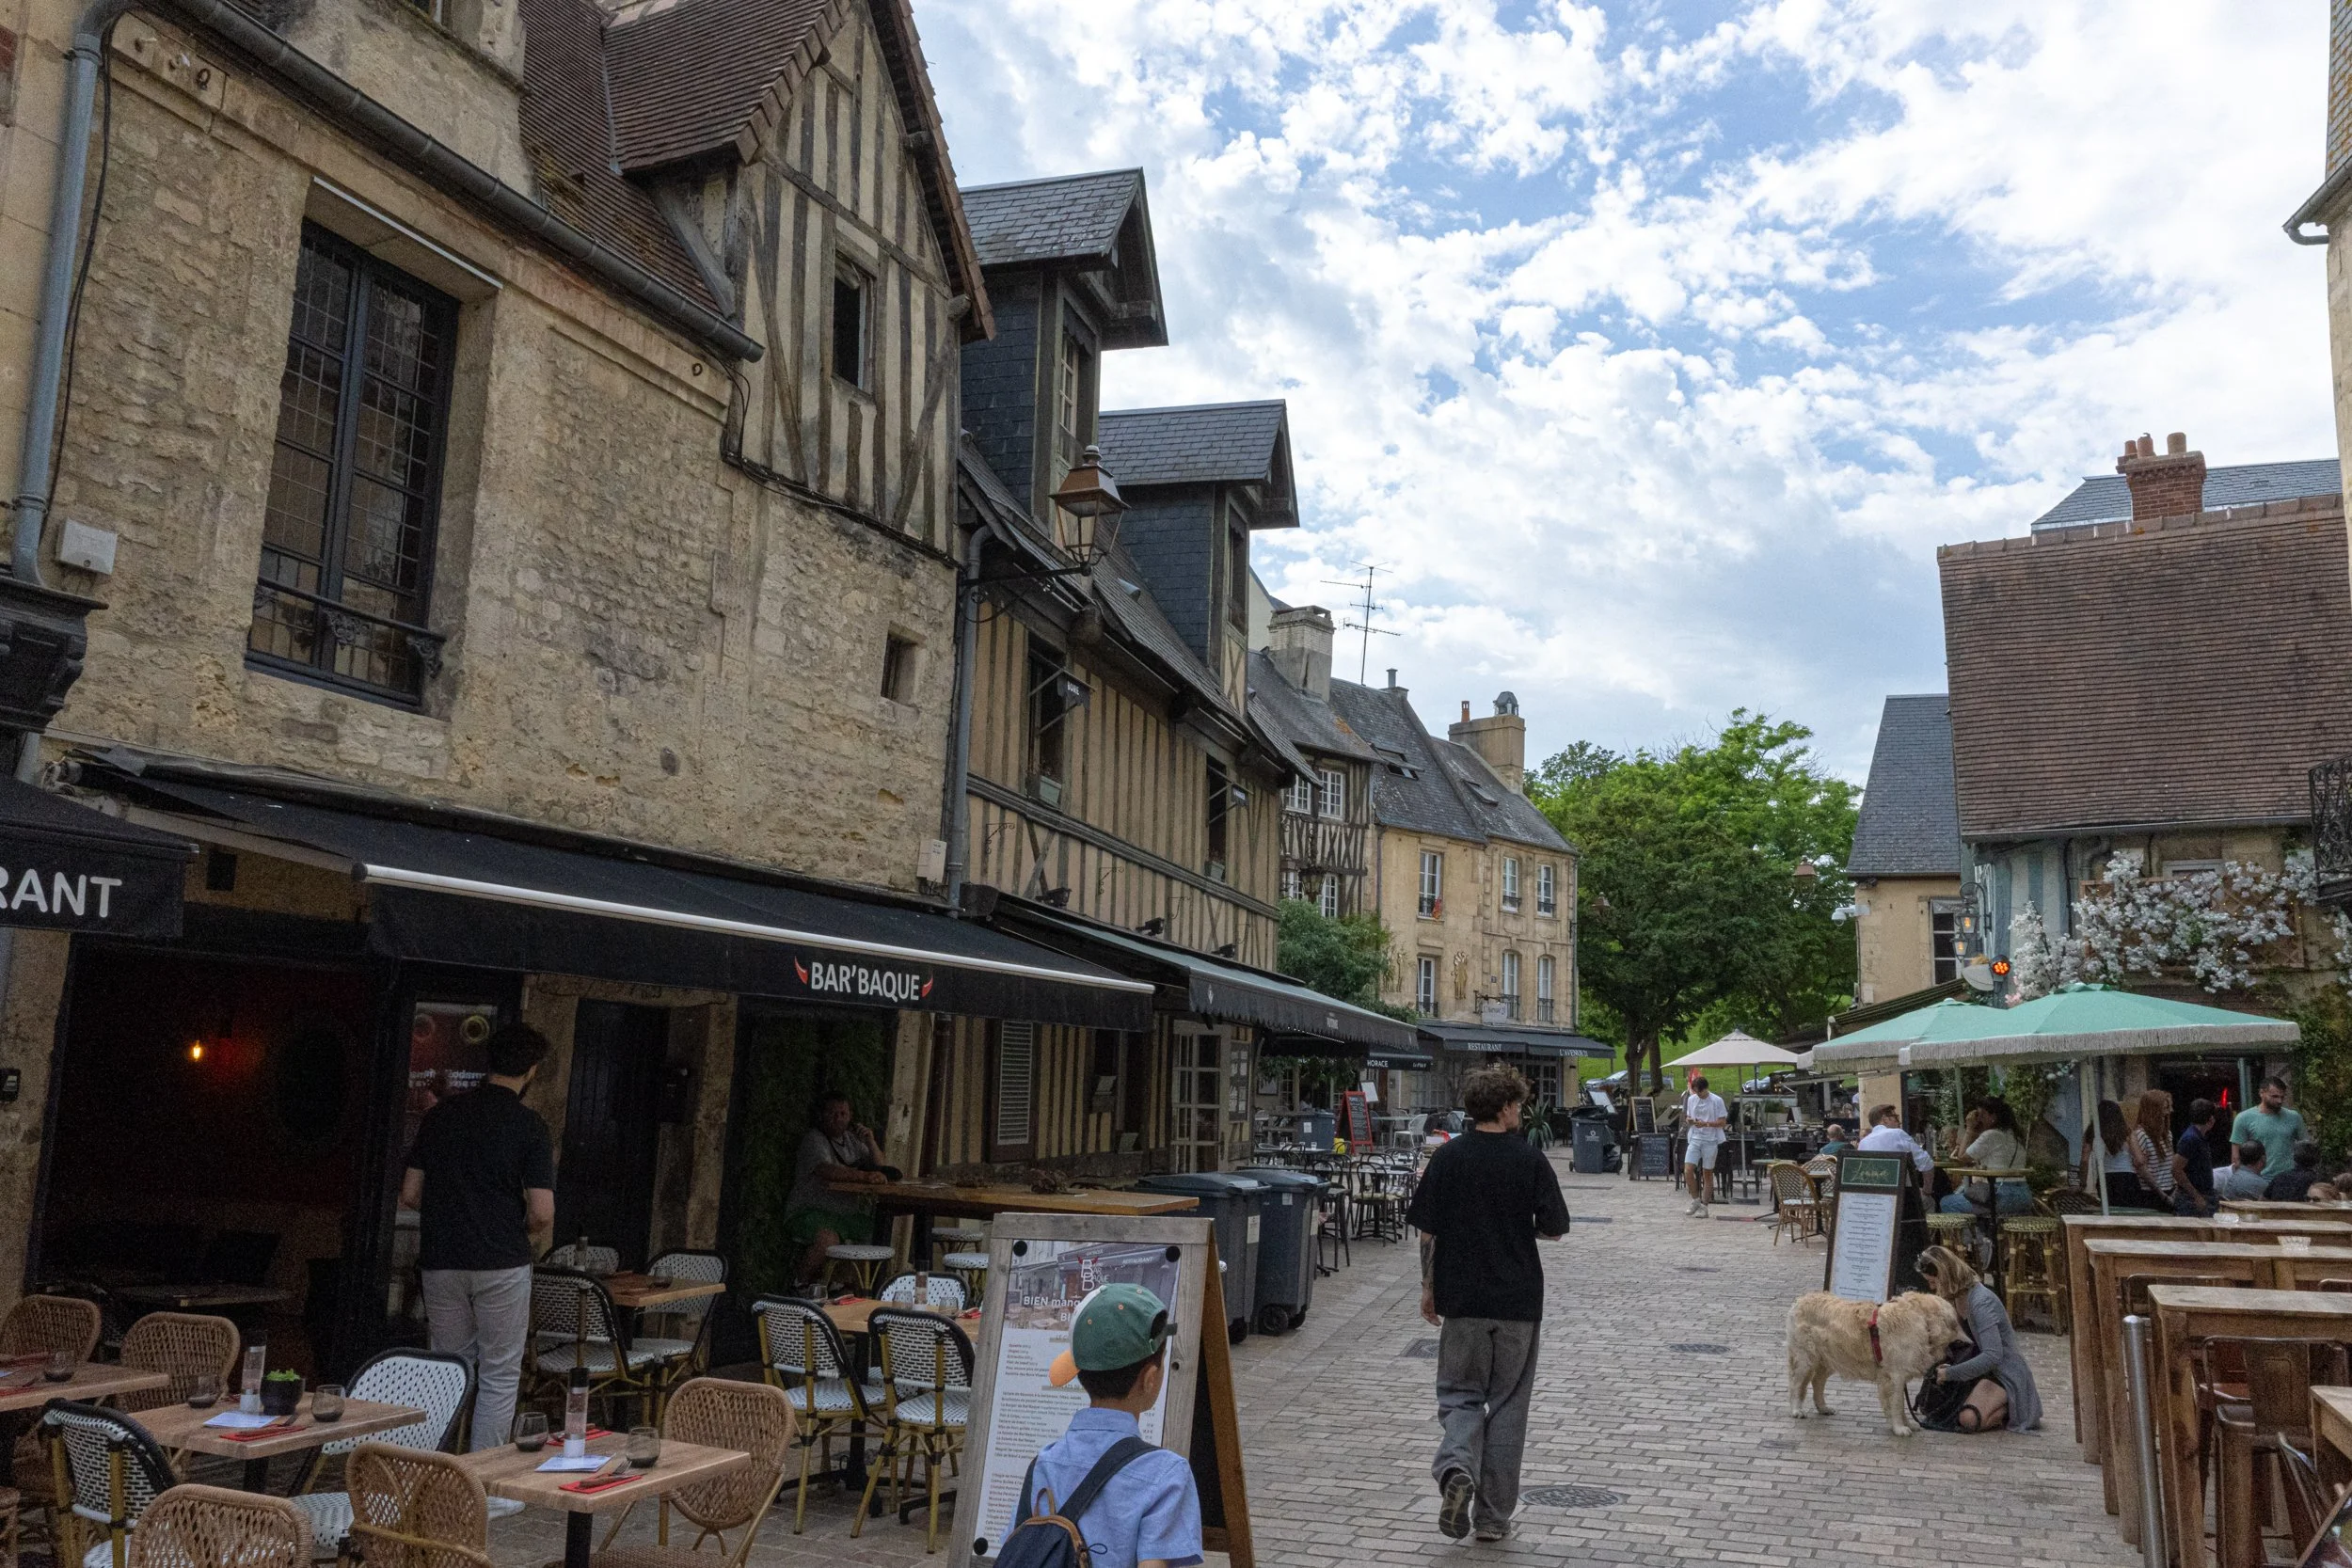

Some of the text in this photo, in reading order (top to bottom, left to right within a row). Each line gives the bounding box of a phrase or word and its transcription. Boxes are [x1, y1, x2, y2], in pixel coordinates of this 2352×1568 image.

[811, 961, 920, 1003] BAR'BAQUE
[1468, 1043, 1502, 1052] RESTAURANT
[1367, 1059, 1389, 1068] HORACE
[1024, 1296, 1049, 1307] BIEN
